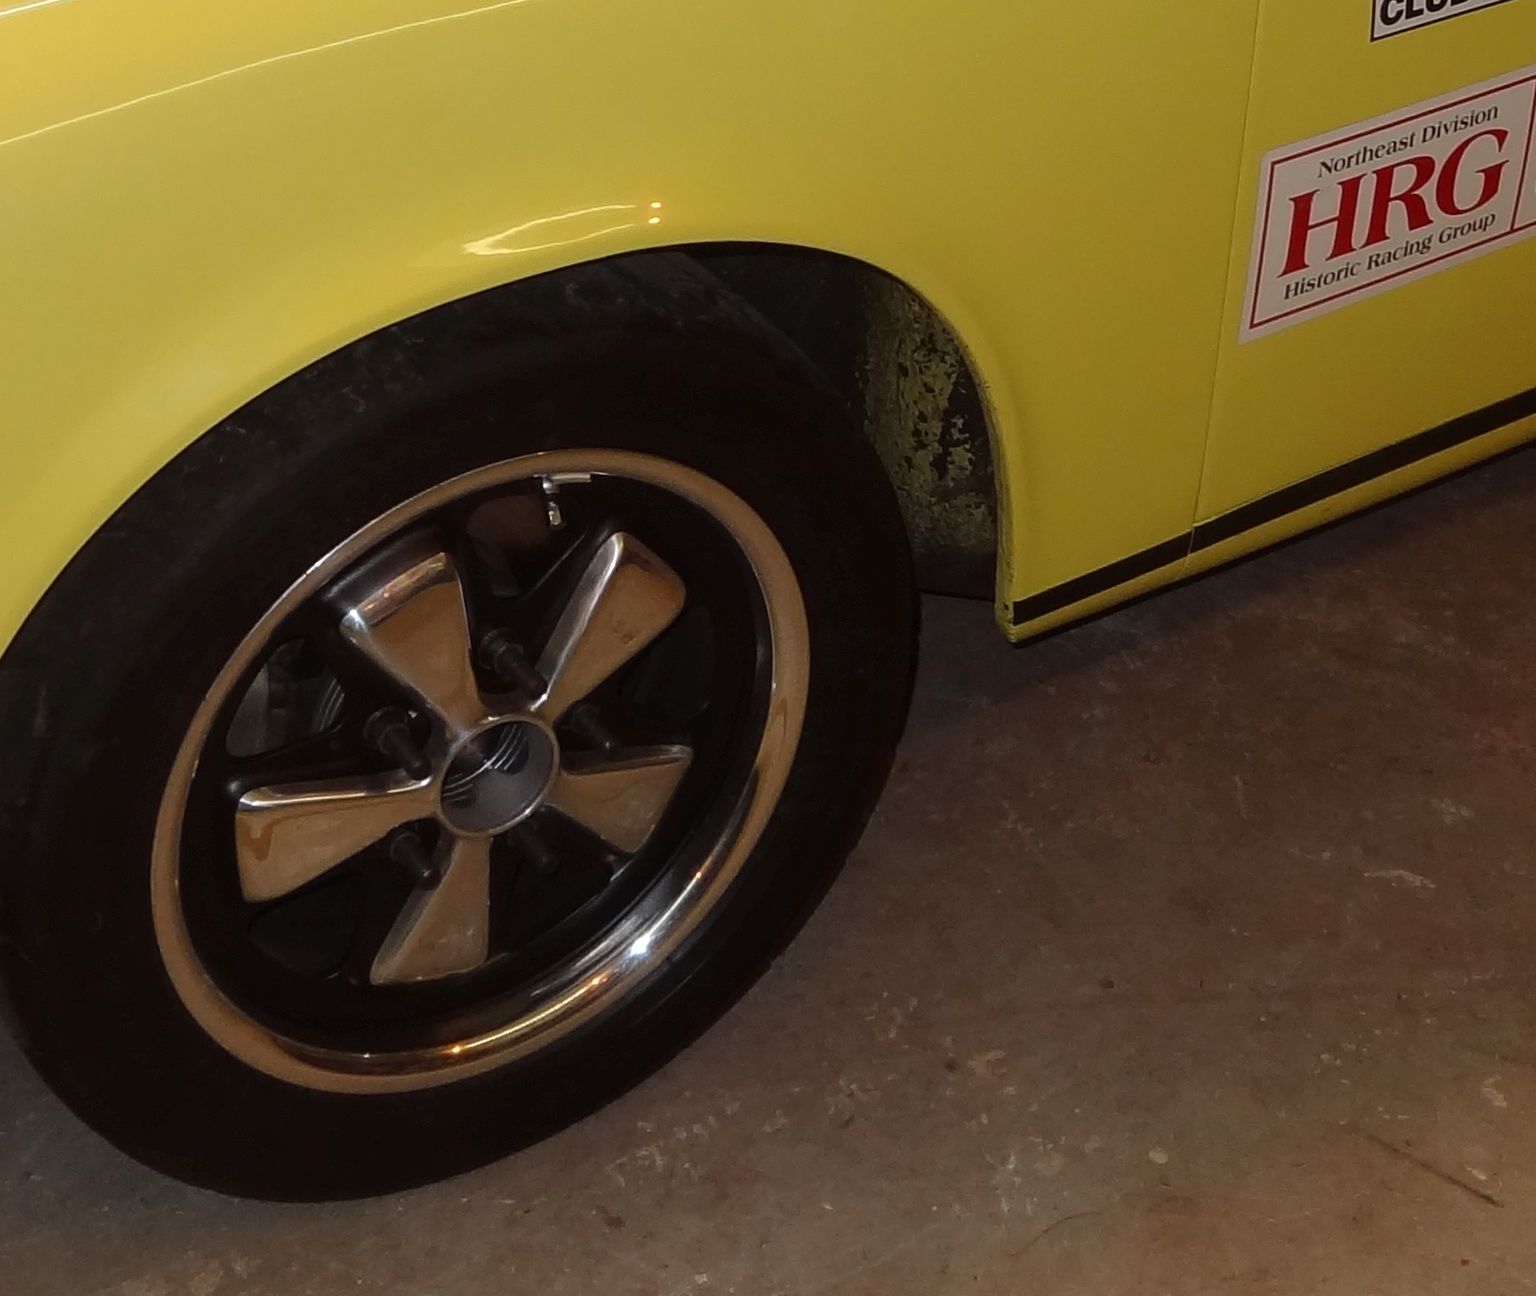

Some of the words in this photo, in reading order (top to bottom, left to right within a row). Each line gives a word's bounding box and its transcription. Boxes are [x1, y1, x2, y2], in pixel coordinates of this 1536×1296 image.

[1317, 132, 1415, 179] Northeast
[1420, 105, 1499, 144] Division
[1276, 128, 1510, 279] HRG
[1282, 262, 1361, 301] Historic
[1366, 233, 1433, 271] Racing
[1438, 212, 1496, 246] Group
